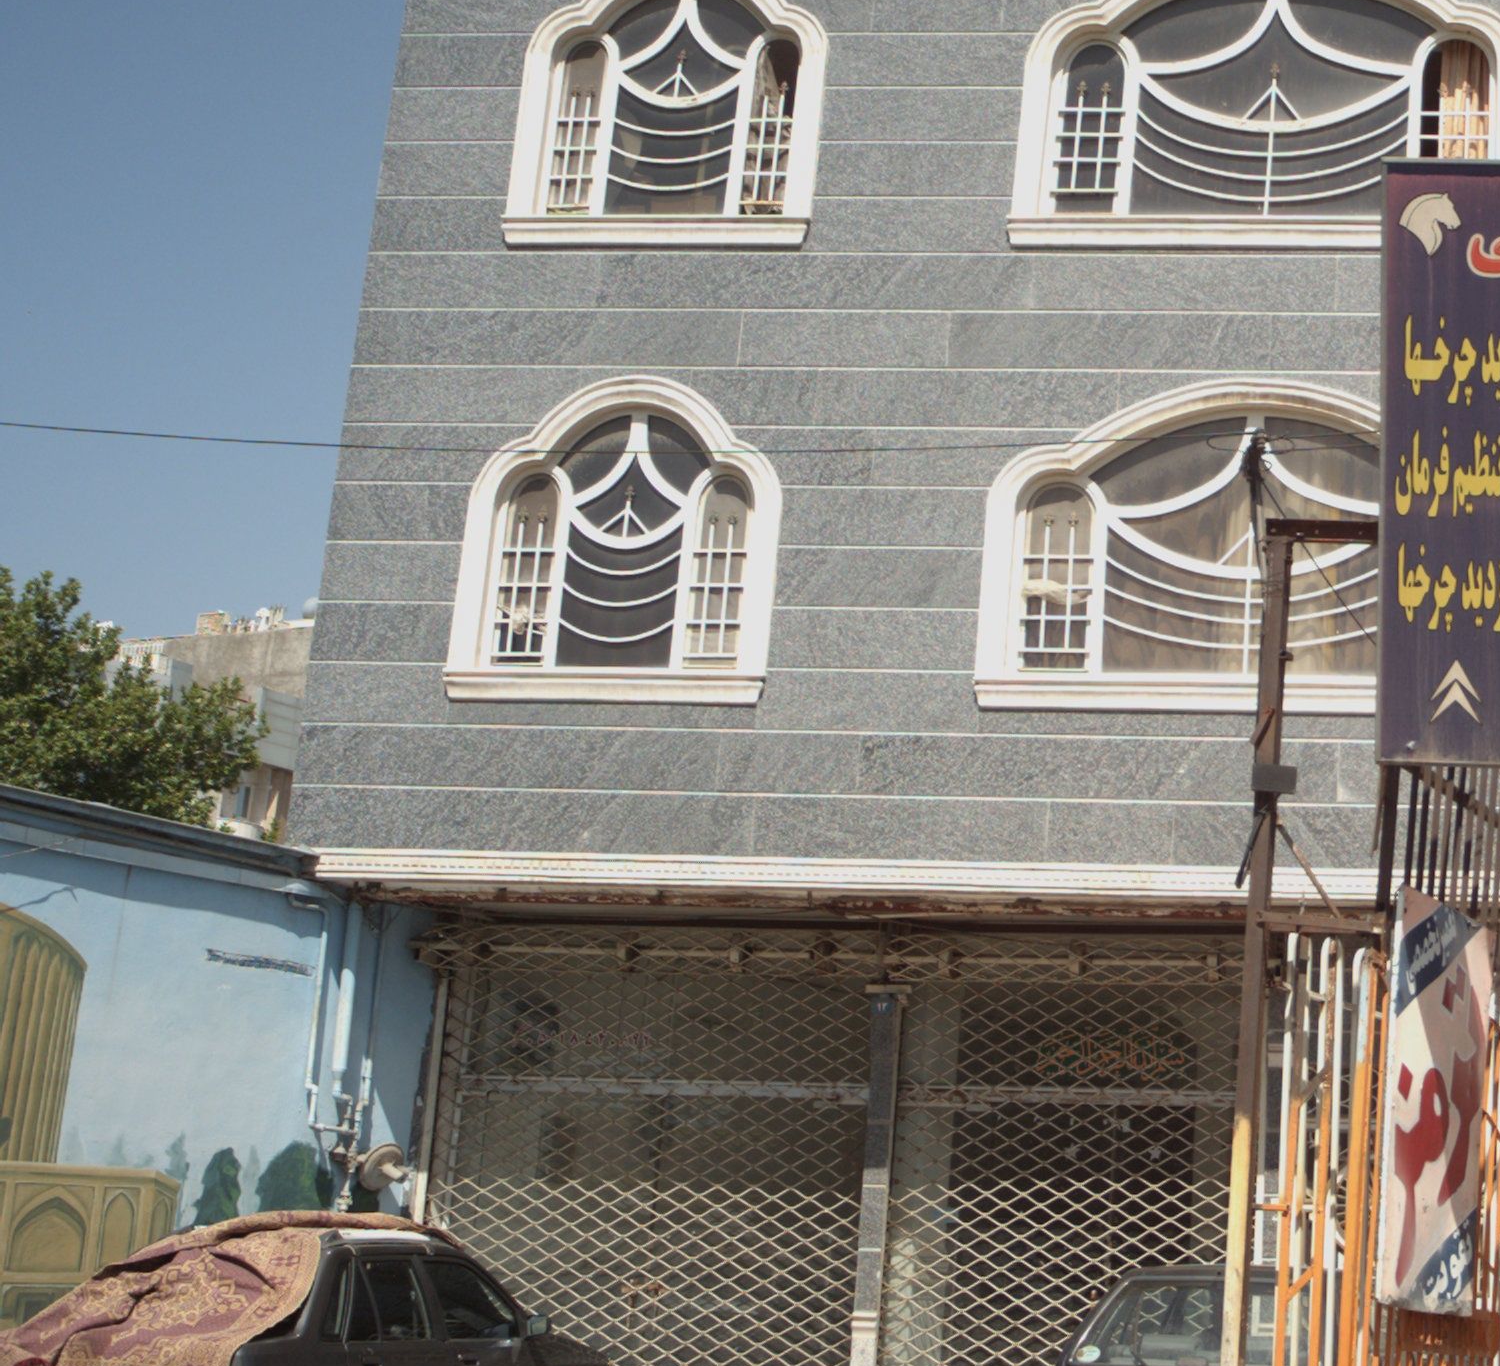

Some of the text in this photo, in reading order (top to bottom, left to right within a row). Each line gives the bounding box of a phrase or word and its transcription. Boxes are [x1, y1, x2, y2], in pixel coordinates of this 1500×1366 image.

[1403, 314, 1478, 407] چرخها
[1393, 425, 1451, 519] فرمان
[1396, 543, 1459, 633] چرخها
[1394, 964, 1487, 1289] ترمز
